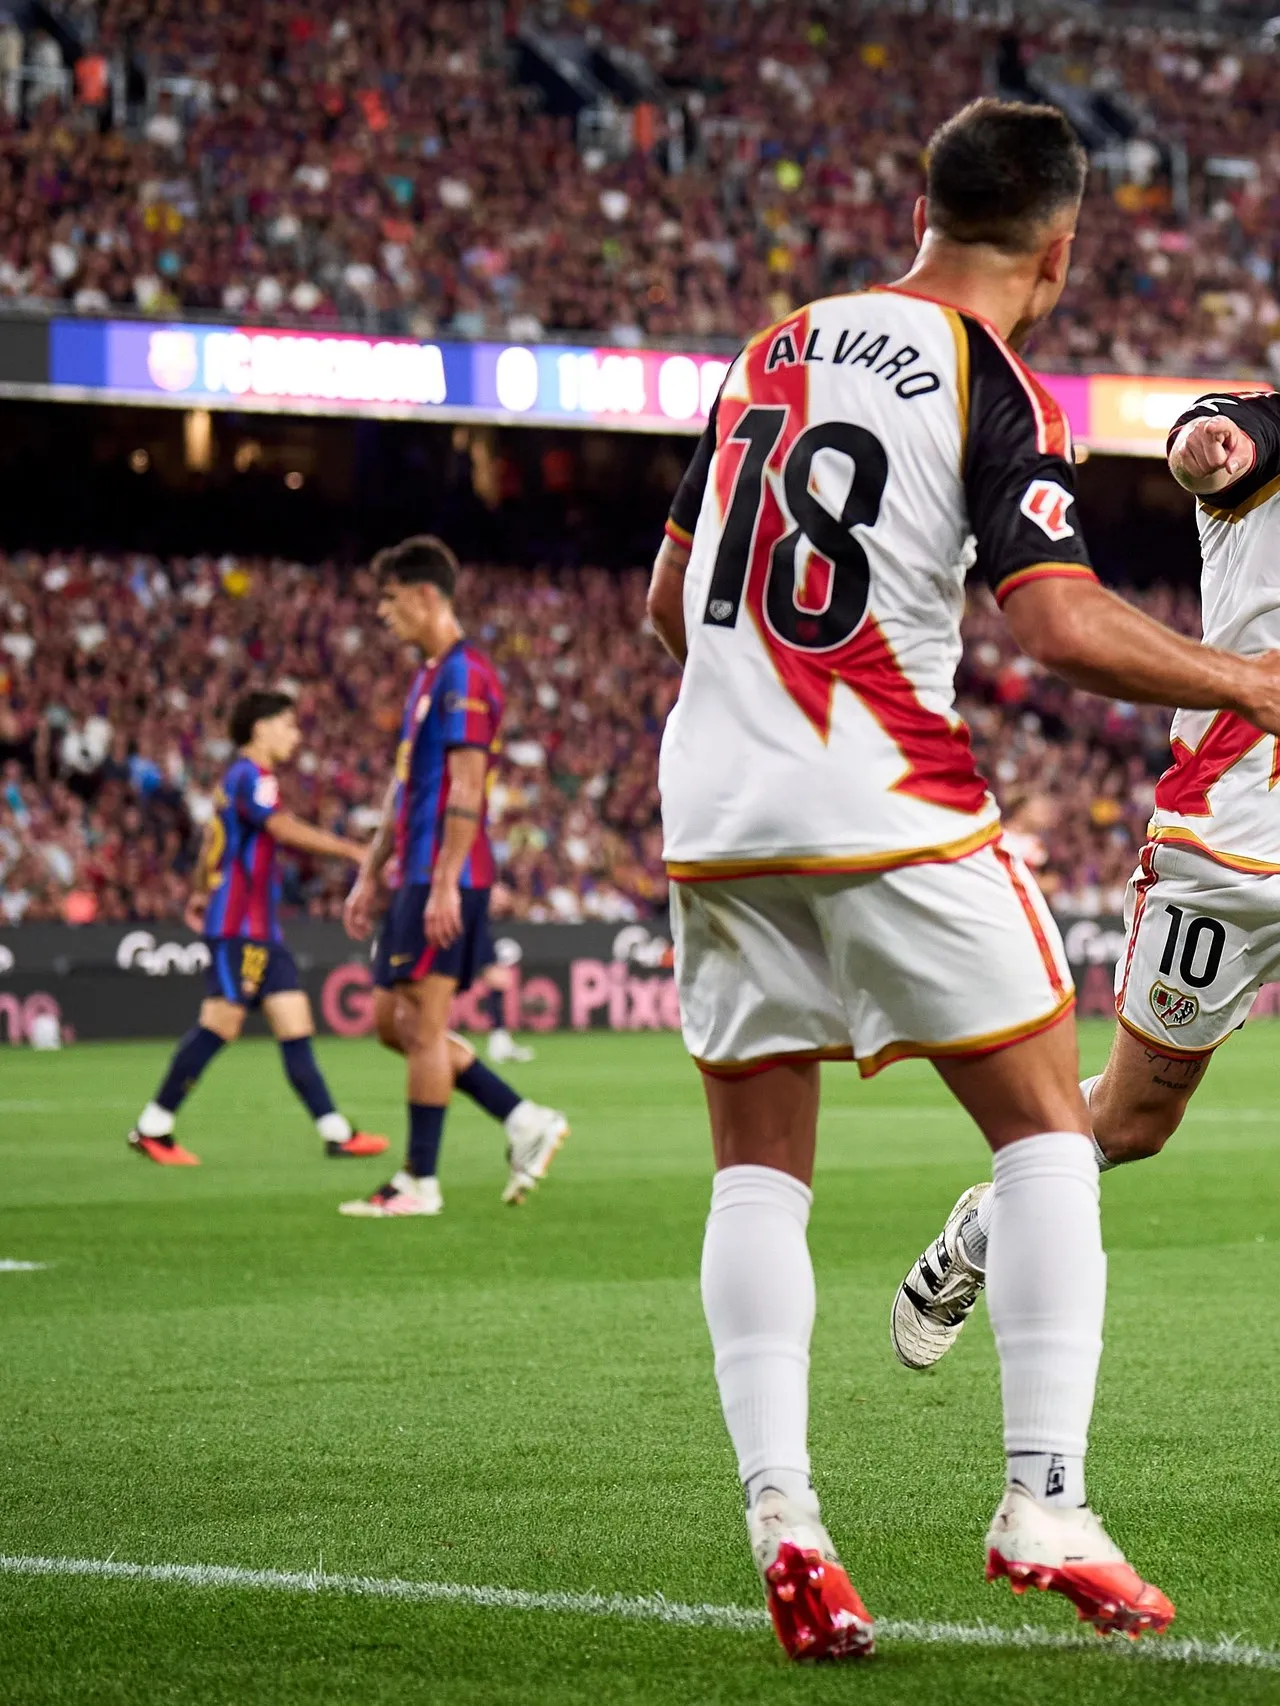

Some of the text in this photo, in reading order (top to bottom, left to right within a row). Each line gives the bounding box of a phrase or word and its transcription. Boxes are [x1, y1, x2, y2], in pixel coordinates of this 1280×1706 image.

[765, 322, 940, 399] ÁLVARO
[703, 406, 889, 651] 18
[1159, 904, 1226, 988] 10
